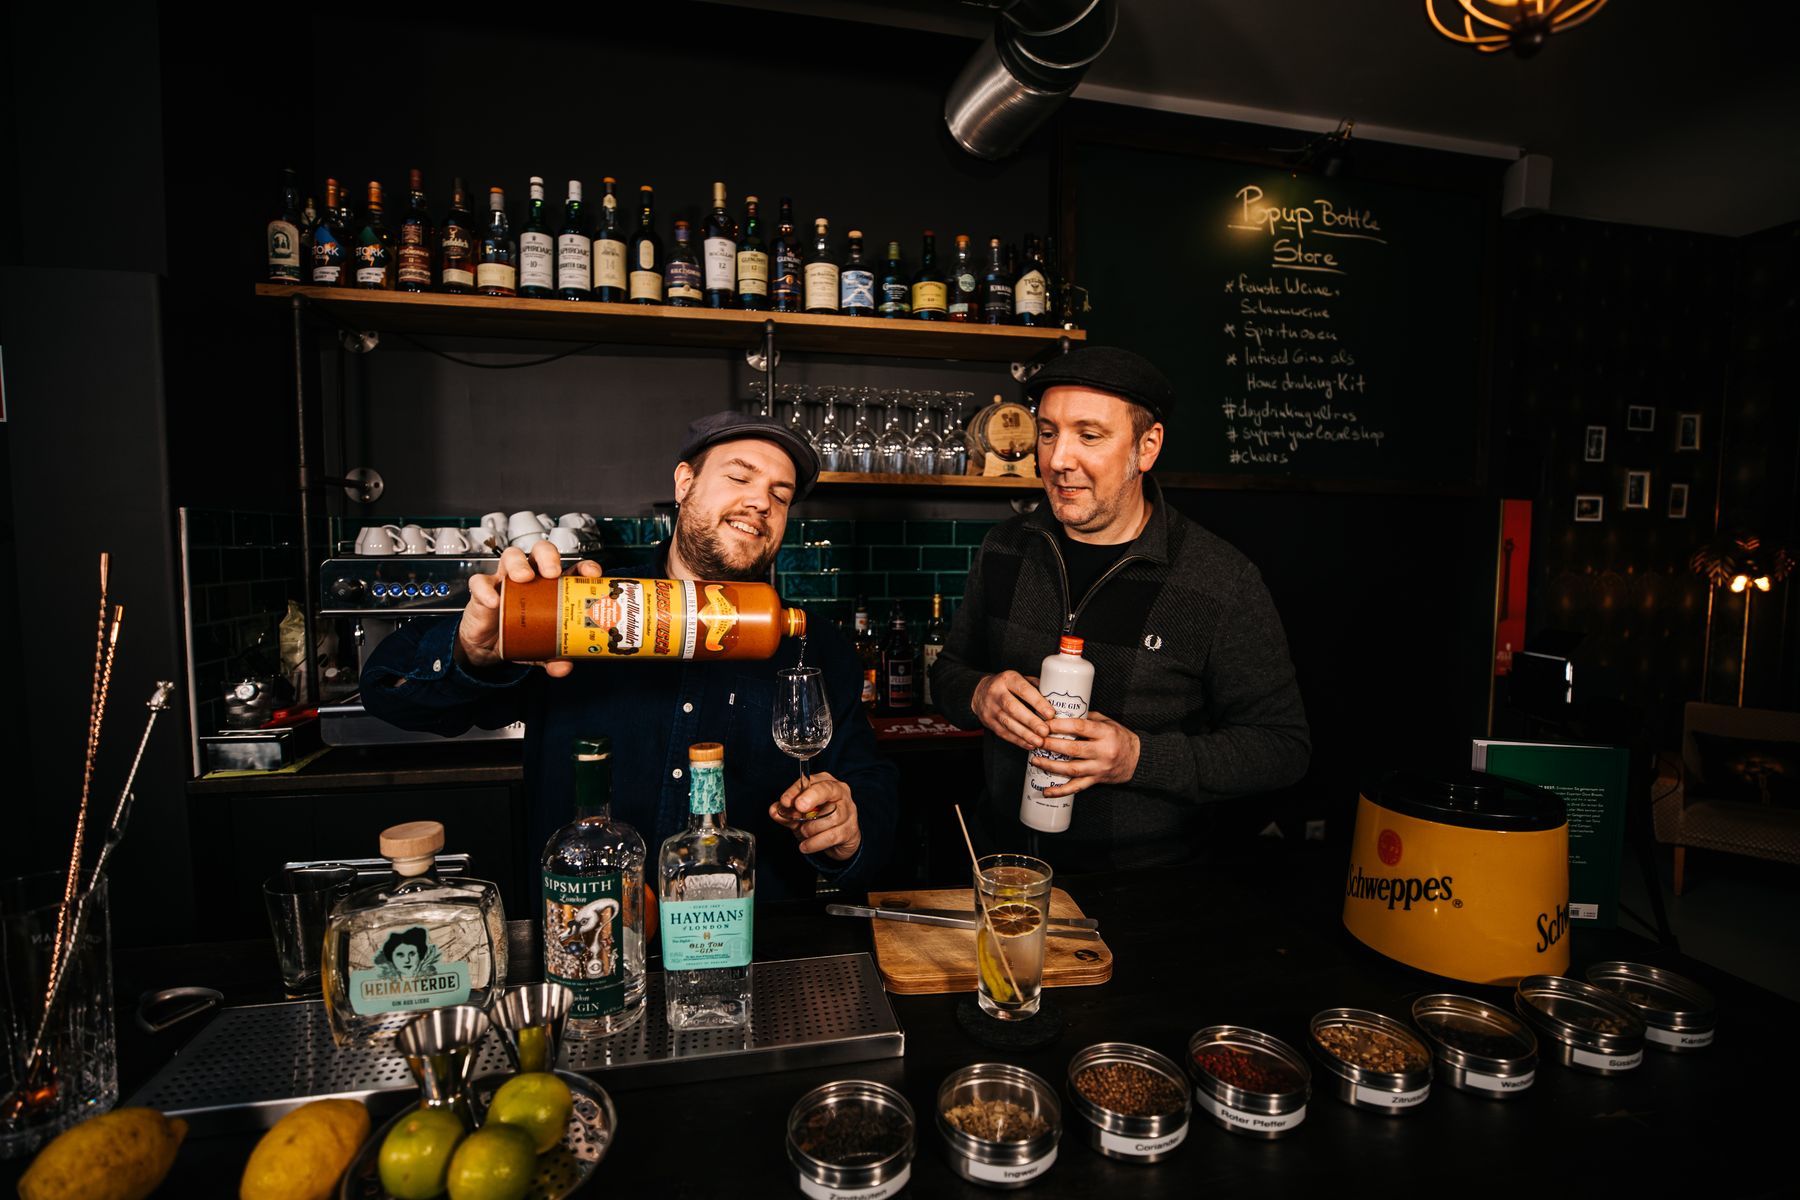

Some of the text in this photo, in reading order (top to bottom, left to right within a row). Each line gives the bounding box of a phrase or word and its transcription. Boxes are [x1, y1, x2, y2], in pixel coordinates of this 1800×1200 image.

[1235, 184, 1381, 239] Popup Bottle
[1273, 239, 1339, 266] Store
[718, 262, 727, 270] 12
[1244, 320, 1338, 347] Spirituosen
[1329, 347, 1356, 366] als
[1067, 702, 1082, 711] GIN
[543, 876, 612, 894] SIPSMITH
[688, 923, 731, 932] LONDON
[689, 942, 705, 950] OLD
[364, 975, 456, 997] HEIMATERDE
[414, 998, 430, 1006] LIEBE
[577, 1002, 600, 1013] GIN
[1220, 1108, 1287, 1129] Roter Pfeffer
[1134, 1136, 1180, 1153] Coriander
[1003, 1165, 1039, 1179] Ingwer
